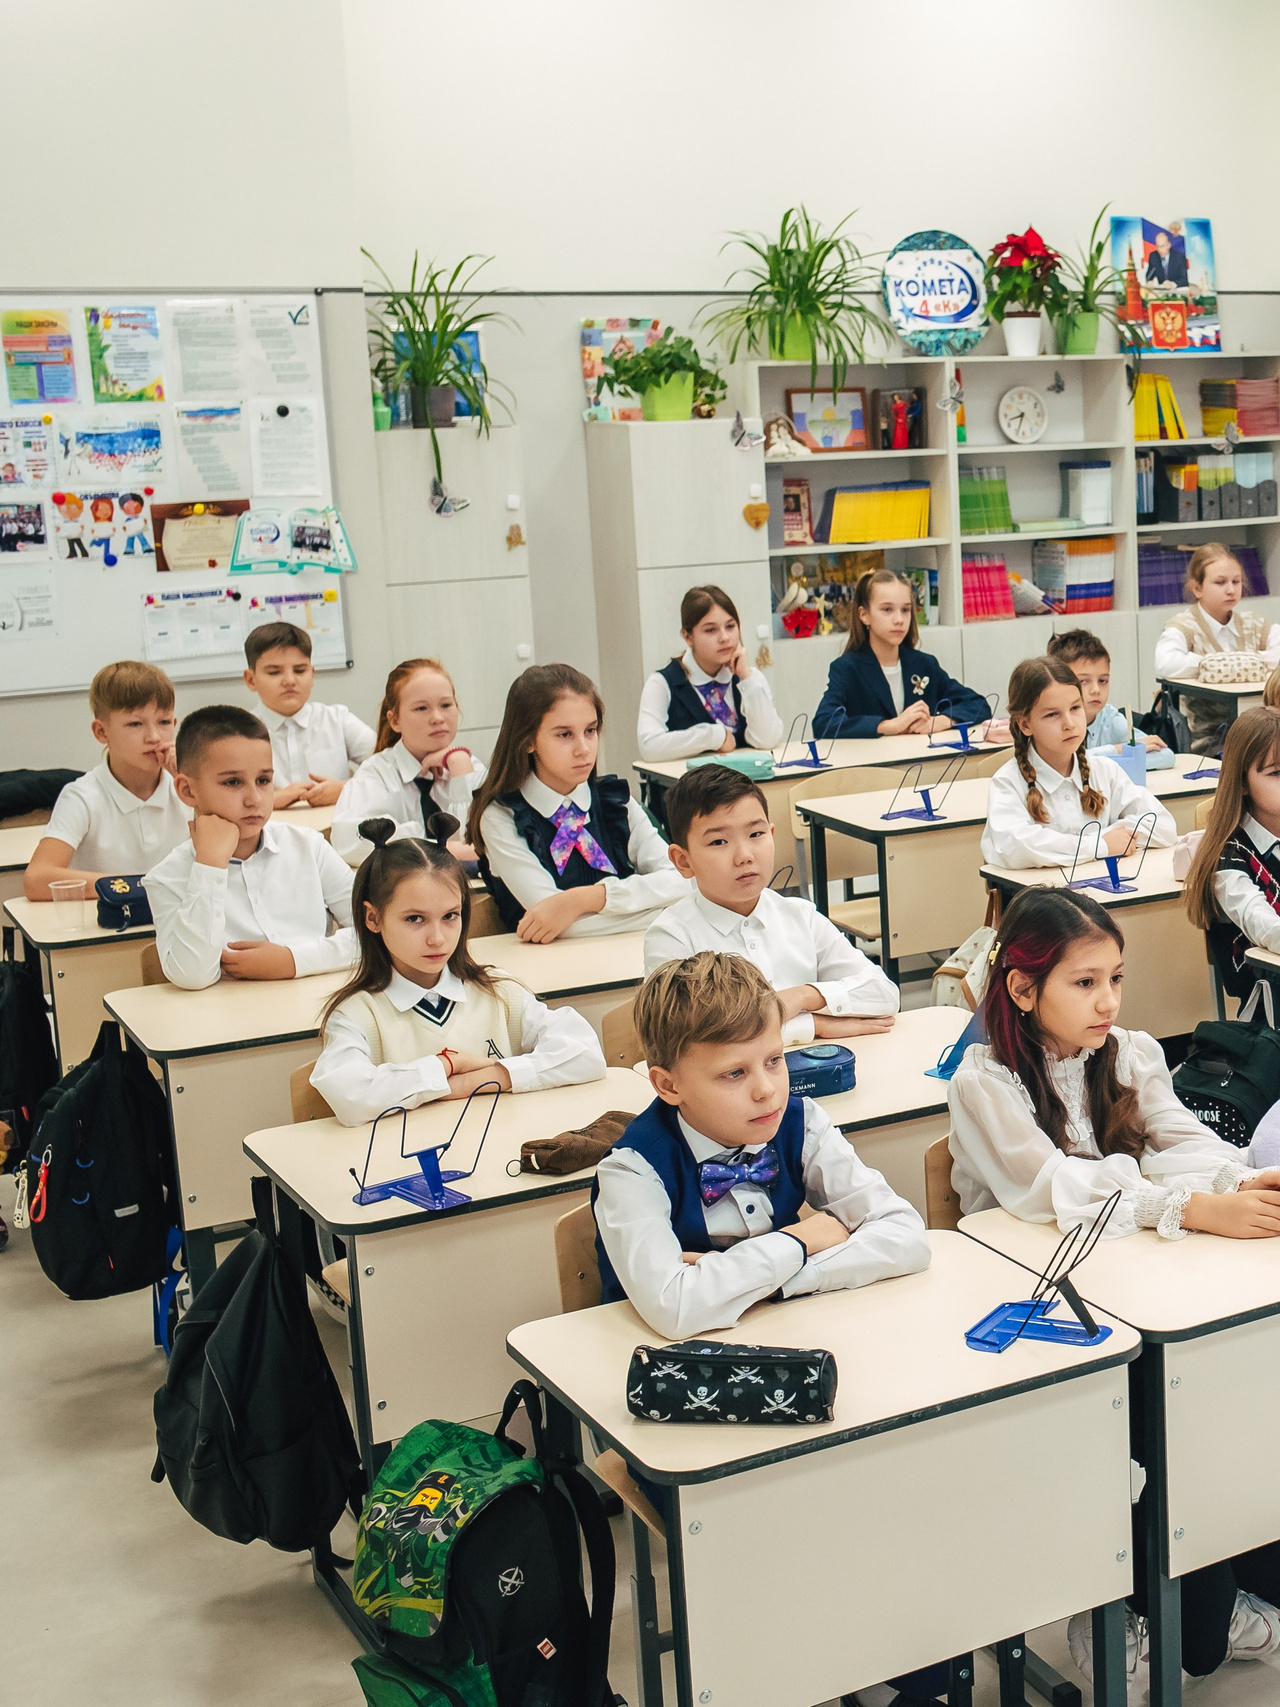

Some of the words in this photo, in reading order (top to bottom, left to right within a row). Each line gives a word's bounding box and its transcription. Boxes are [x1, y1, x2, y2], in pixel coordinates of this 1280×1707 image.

[893, 278, 970, 297] КОМЕТА
[919, 299, 930, 316] 4
[790, 1083, 816, 1092] CKMANN
